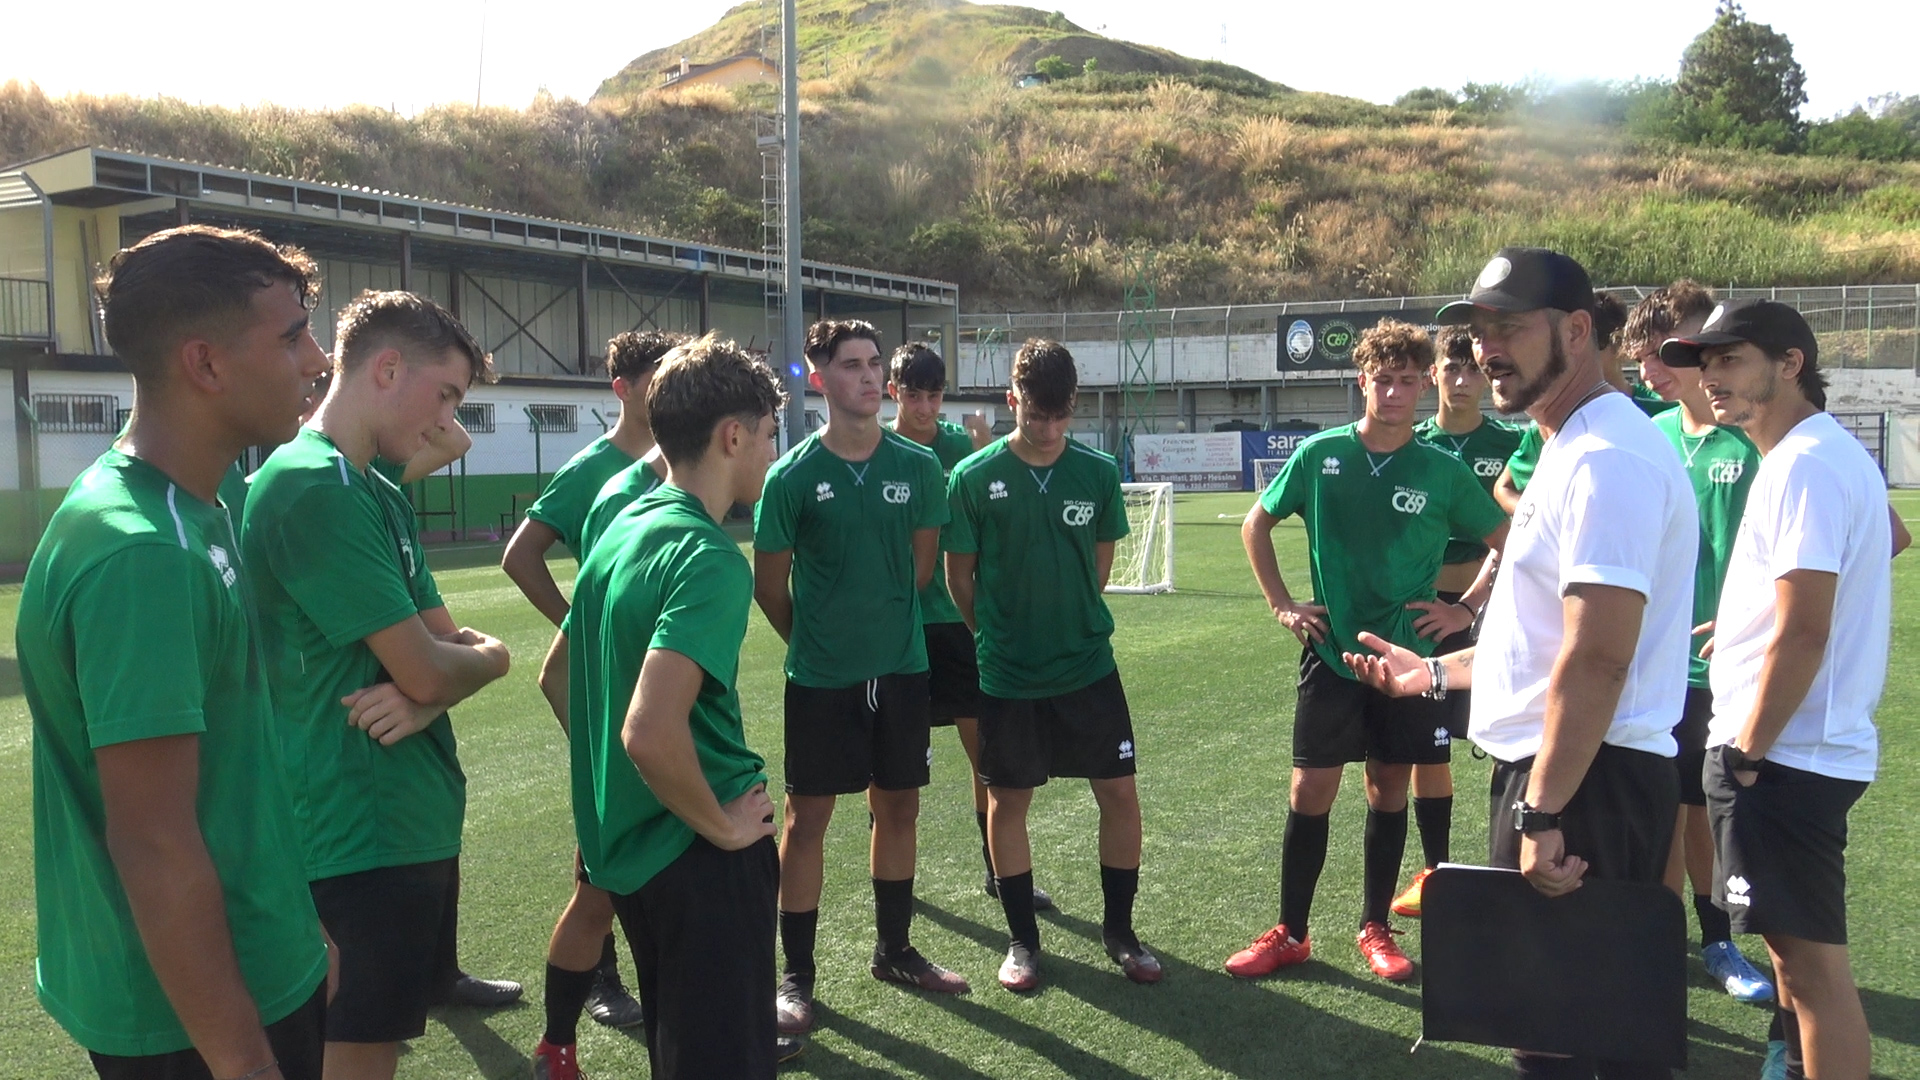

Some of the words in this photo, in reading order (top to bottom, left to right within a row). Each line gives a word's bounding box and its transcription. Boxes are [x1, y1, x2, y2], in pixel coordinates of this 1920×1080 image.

[1327, 333, 1349, 347] C69
[1207, 473, 1237, 481] Messina
[1473, 460, 1503, 477] C69
[1708, 463, 1743, 484] C69
[882, 485, 911, 505] C69
[1391, 491, 1427, 515] C69
[1062, 504, 1095, 526] C69
